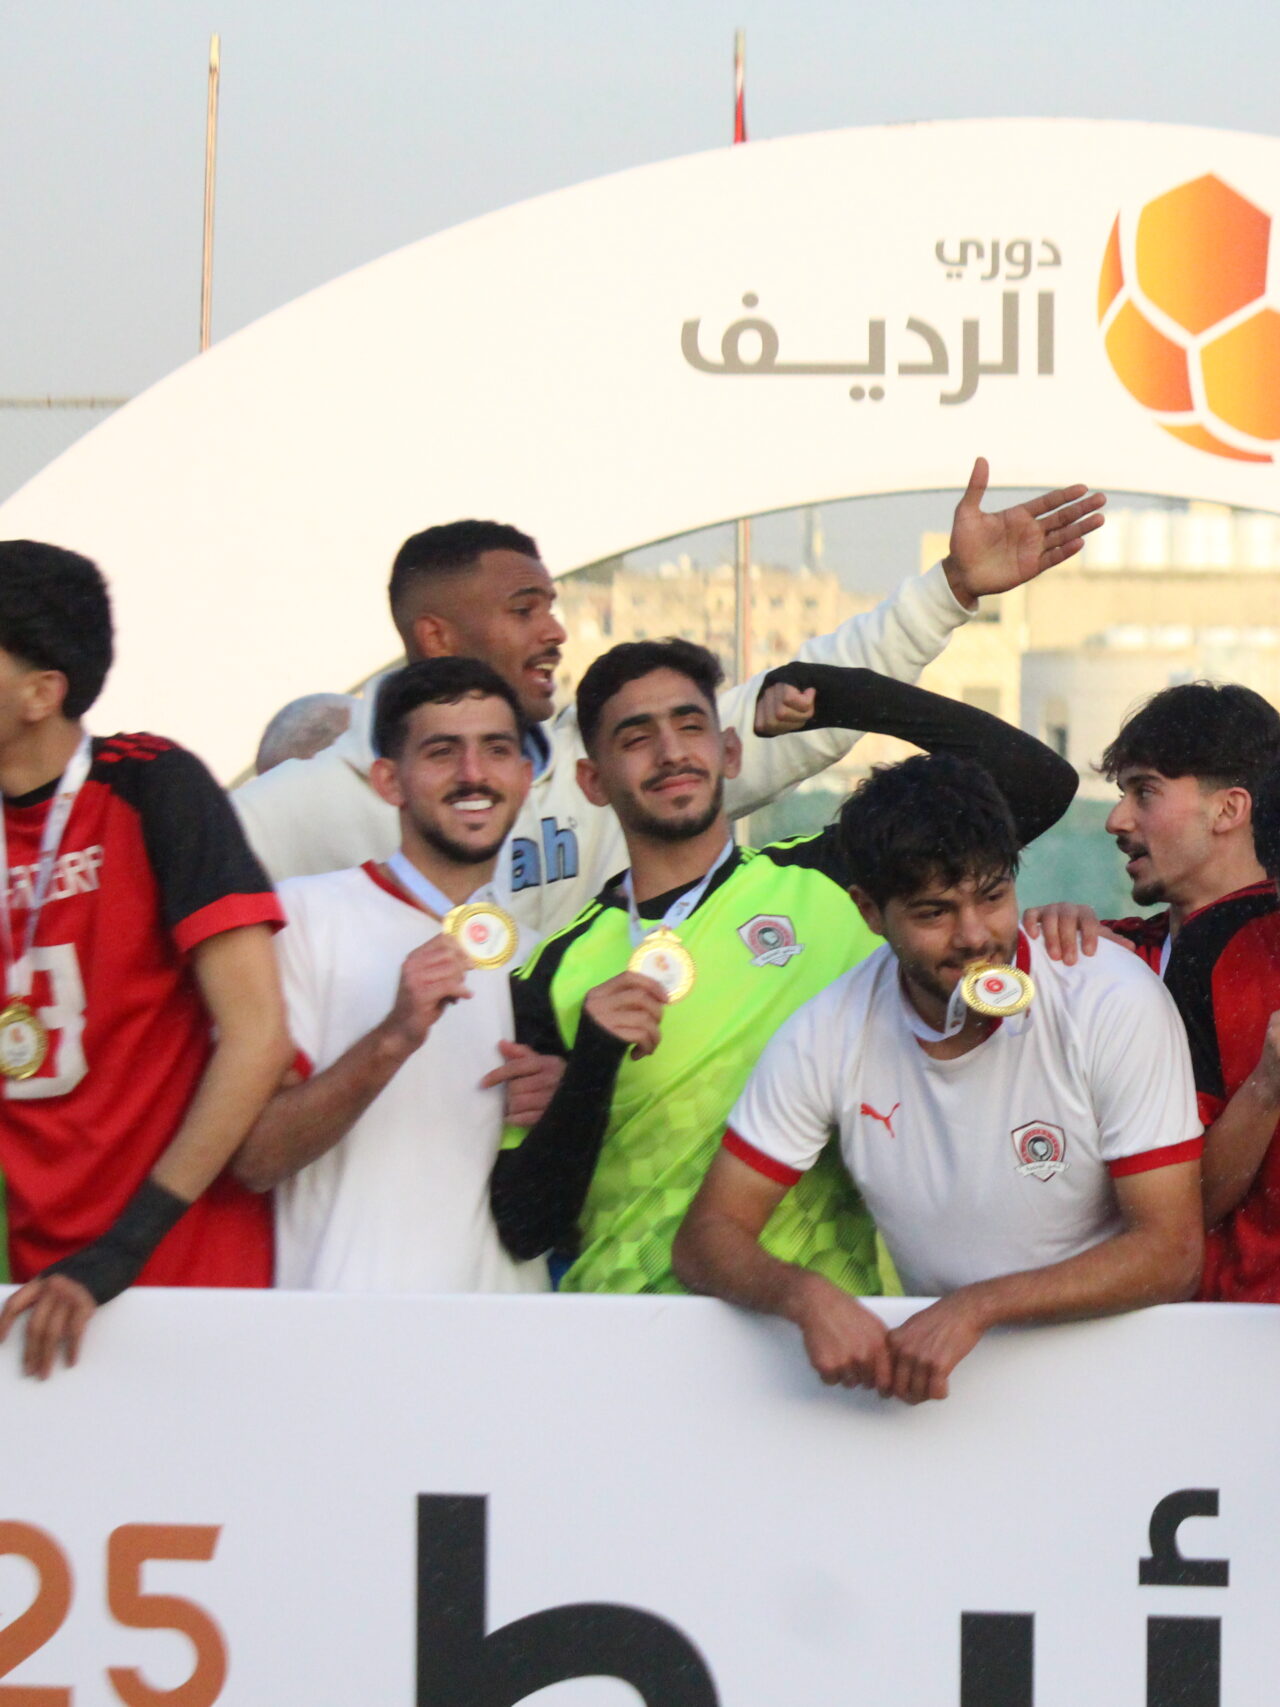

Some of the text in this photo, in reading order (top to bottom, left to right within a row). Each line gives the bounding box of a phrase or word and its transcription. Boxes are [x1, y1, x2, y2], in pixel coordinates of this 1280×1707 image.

[935, 239, 1062, 281] دوري
[680, 291, 1055, 405] الرديف
[0, 1519, 230, 1707] 25
